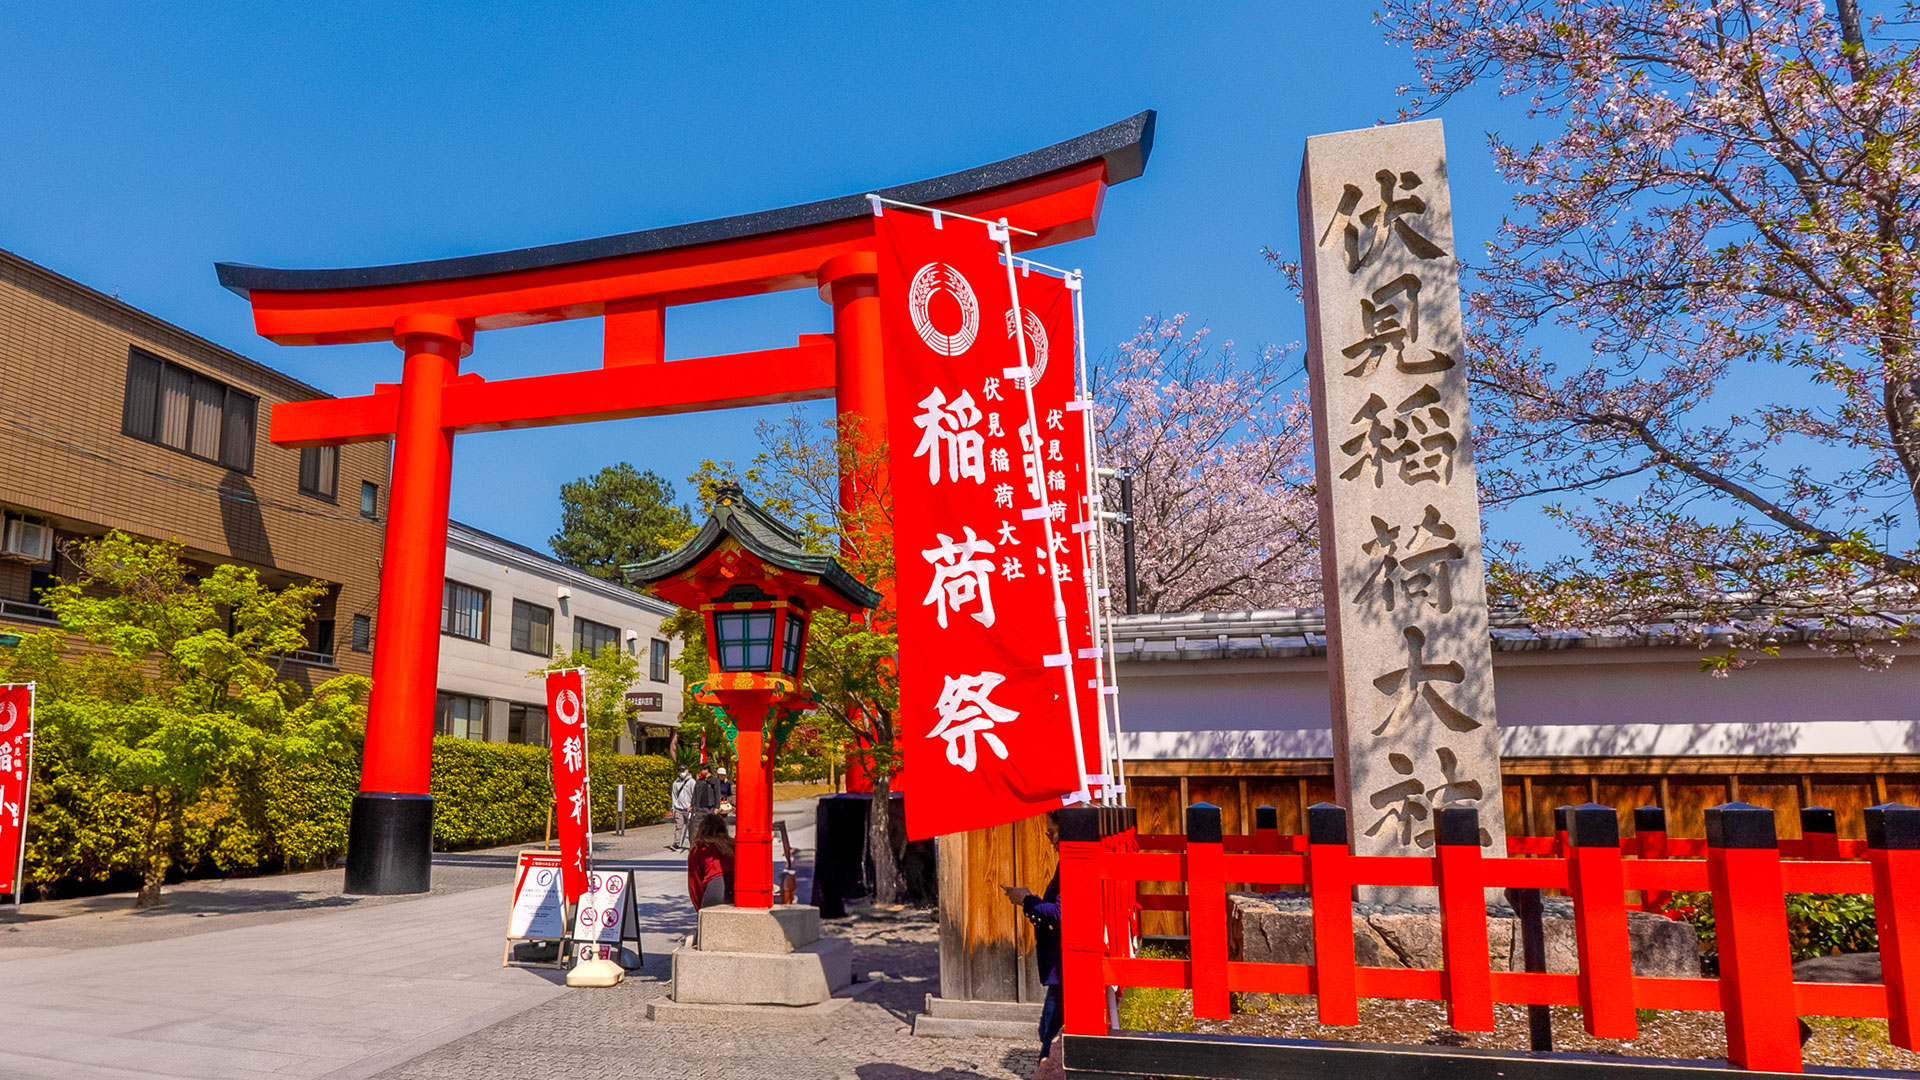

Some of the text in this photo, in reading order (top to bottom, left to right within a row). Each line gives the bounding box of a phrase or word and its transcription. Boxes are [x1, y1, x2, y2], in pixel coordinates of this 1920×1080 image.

[913, 386, 1020, 772] 稲荷祭
[982, 377, 1026, 582] 伏見稲荷大社
[1045, 409, 1074, 583] 伏見稲荷大社
